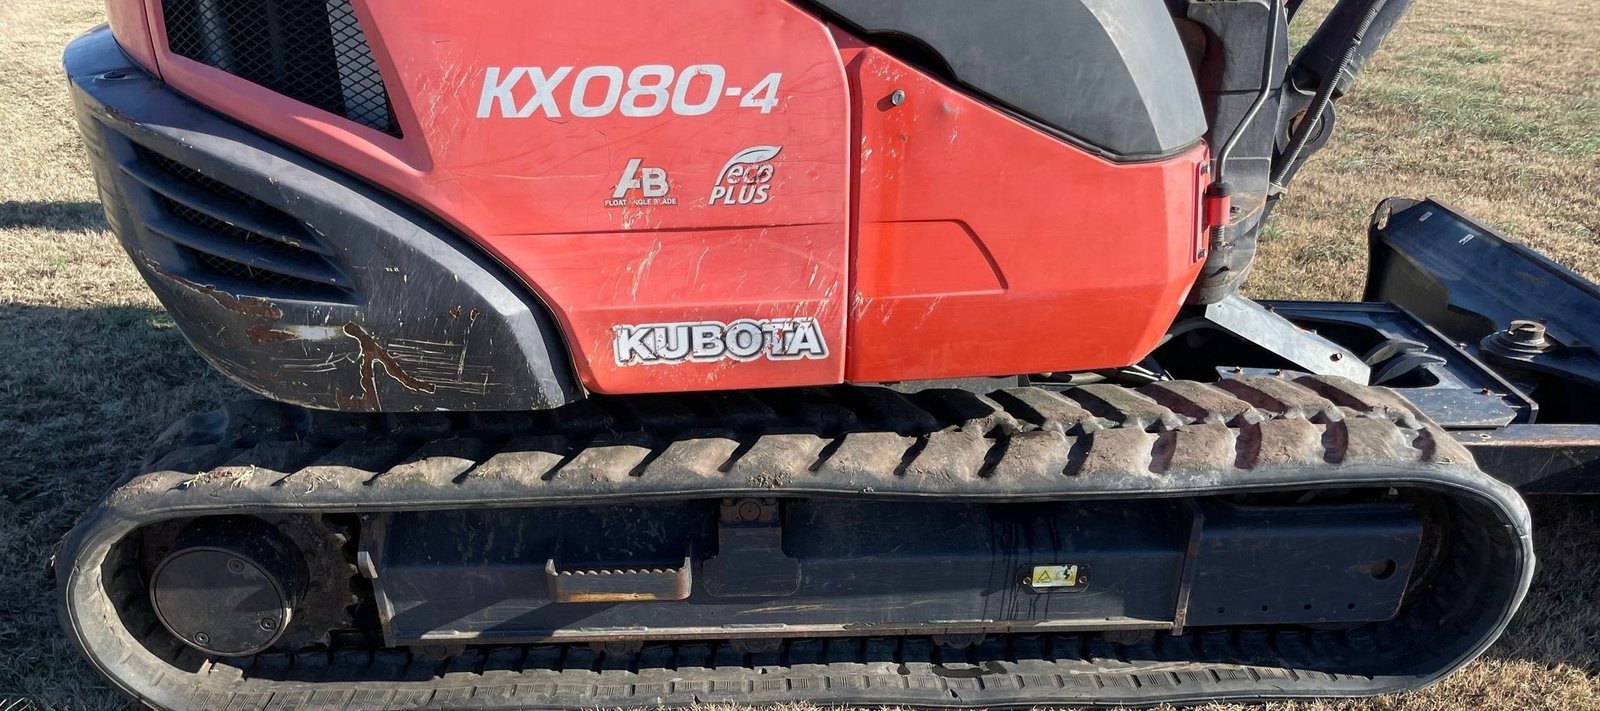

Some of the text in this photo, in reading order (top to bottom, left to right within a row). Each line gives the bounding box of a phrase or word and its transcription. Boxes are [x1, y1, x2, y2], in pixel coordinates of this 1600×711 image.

[476, 64, 783, 119] KX080-4
[727, 164, 773, 185] eco
[604, 199, 627, 207] FLOAT
[708, 185, 771, 206] PLUS
[615, 321, 826, 362] KUBOTA
